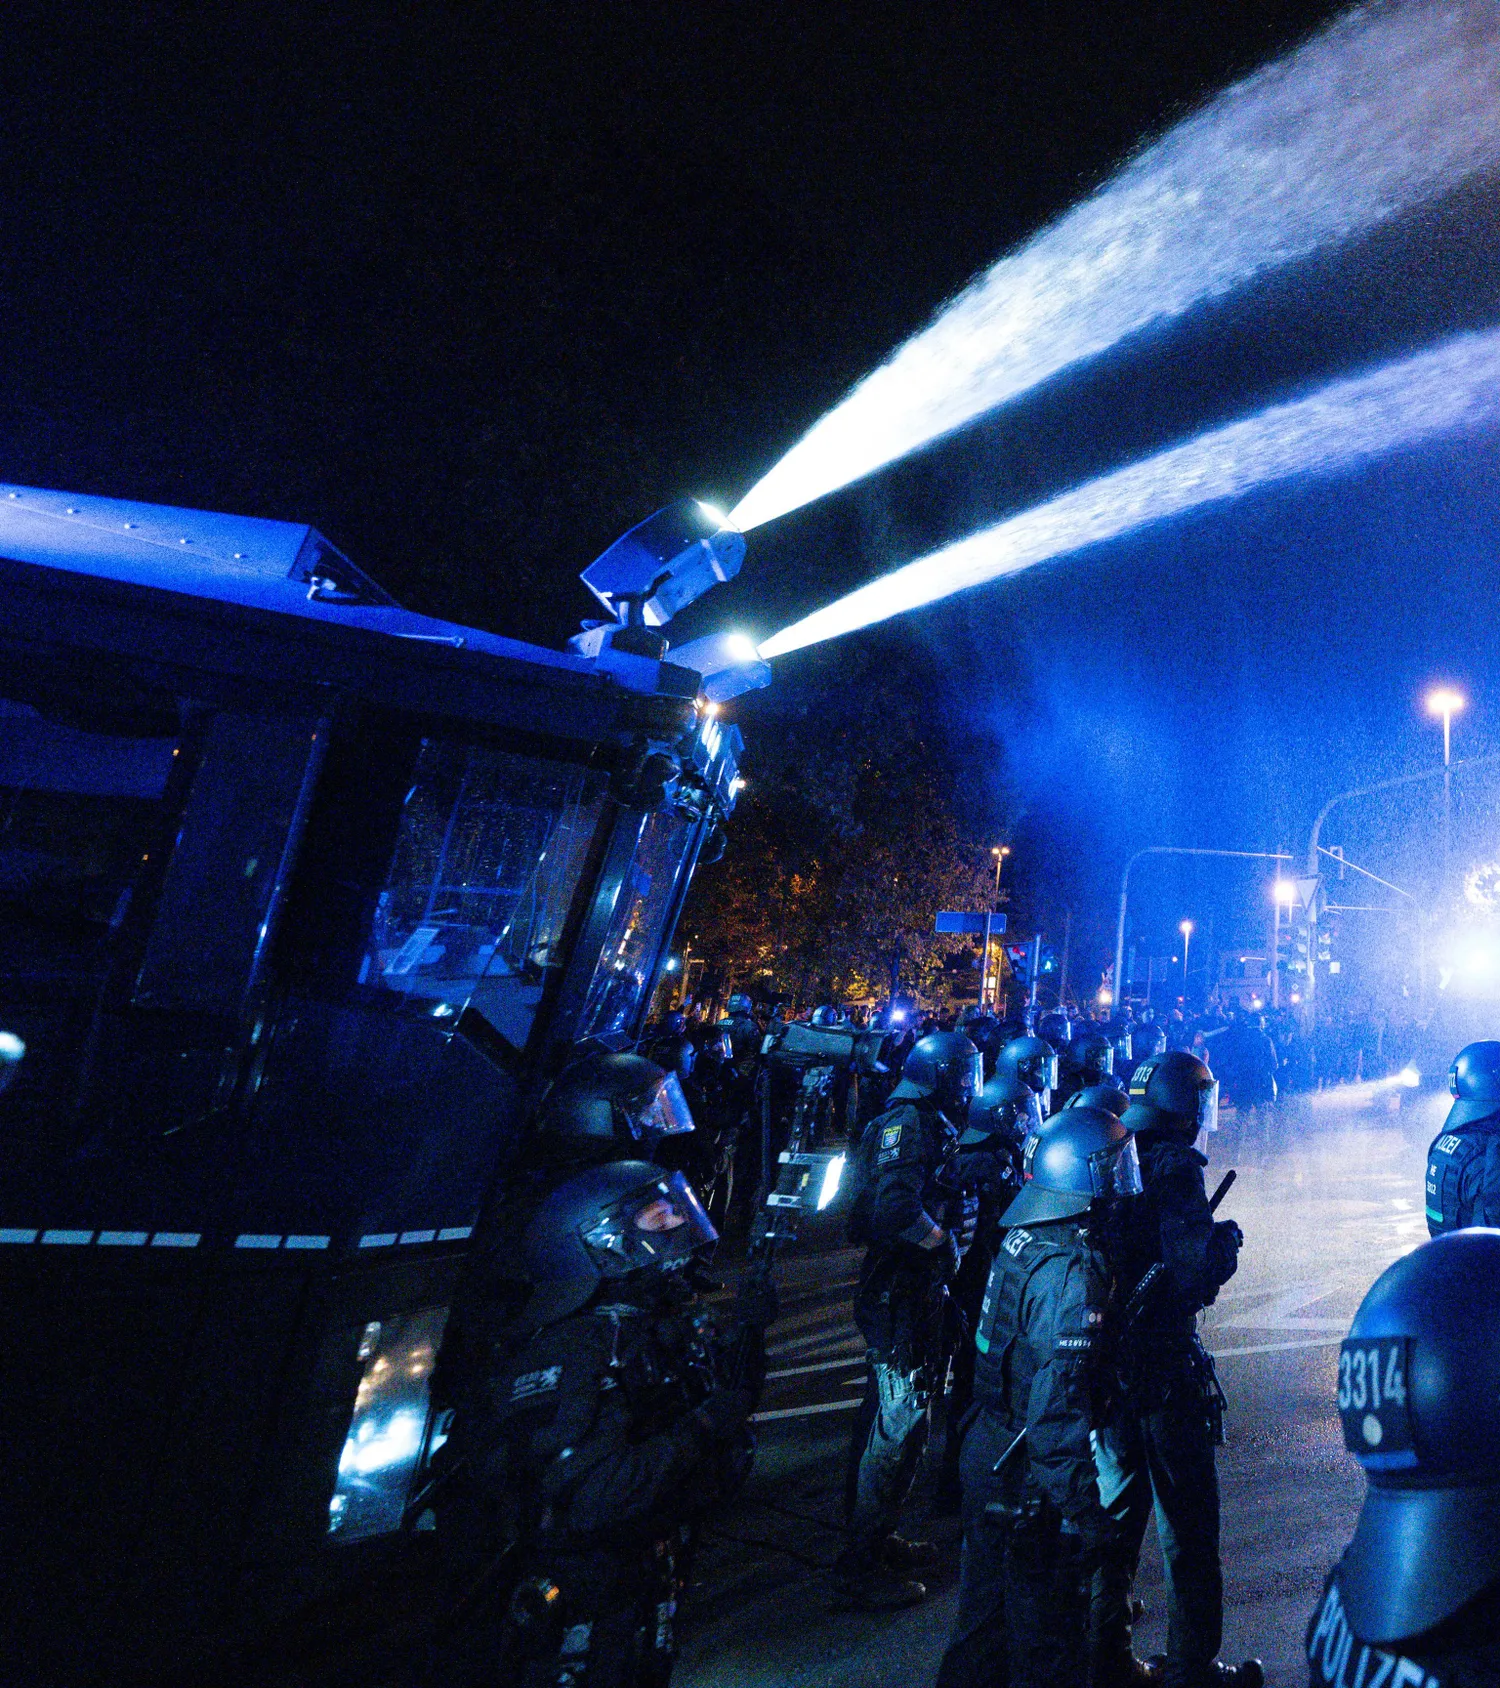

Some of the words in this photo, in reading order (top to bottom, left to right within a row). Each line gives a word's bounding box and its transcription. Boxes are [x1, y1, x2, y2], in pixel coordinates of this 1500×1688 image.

[1435, 1134, 1461, 1155] LIZEI
[1003, 1226, 1033, 1255] IZEI
[1338, 1346, 1406, 1410] 3314
[1308, 1584, 1440, 1688] POLIZE
